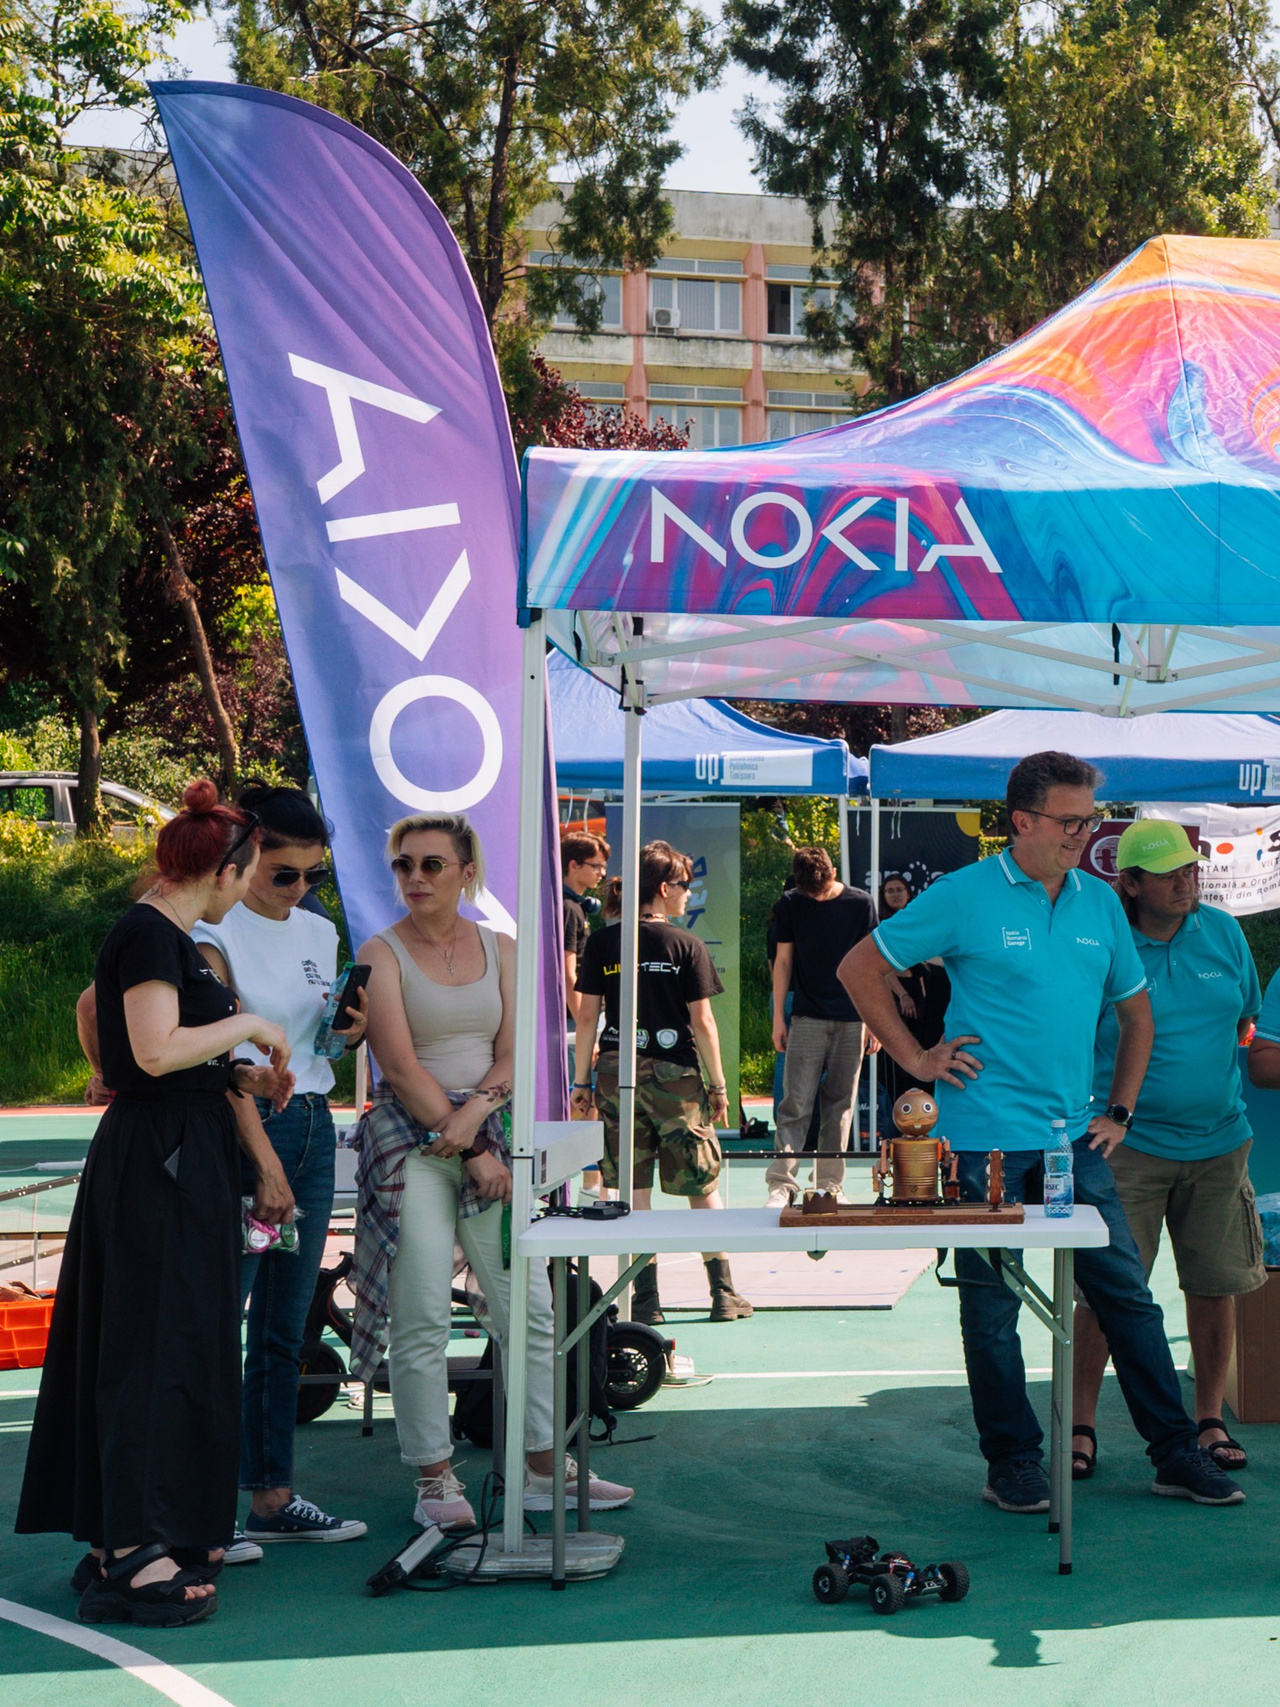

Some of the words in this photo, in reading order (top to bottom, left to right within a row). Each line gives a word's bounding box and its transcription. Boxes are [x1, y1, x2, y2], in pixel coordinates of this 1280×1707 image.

[650, 485, 1003, 573] NOKIA
[1142, 839, 1169, 852] NOKIA
[1198, 881, 1237, 889] țională
[1236, 891, 1252, 899] din
[1076, 937, 1100, 947] NOKIA
[1198, 971, 1223, 980] NOKIA
